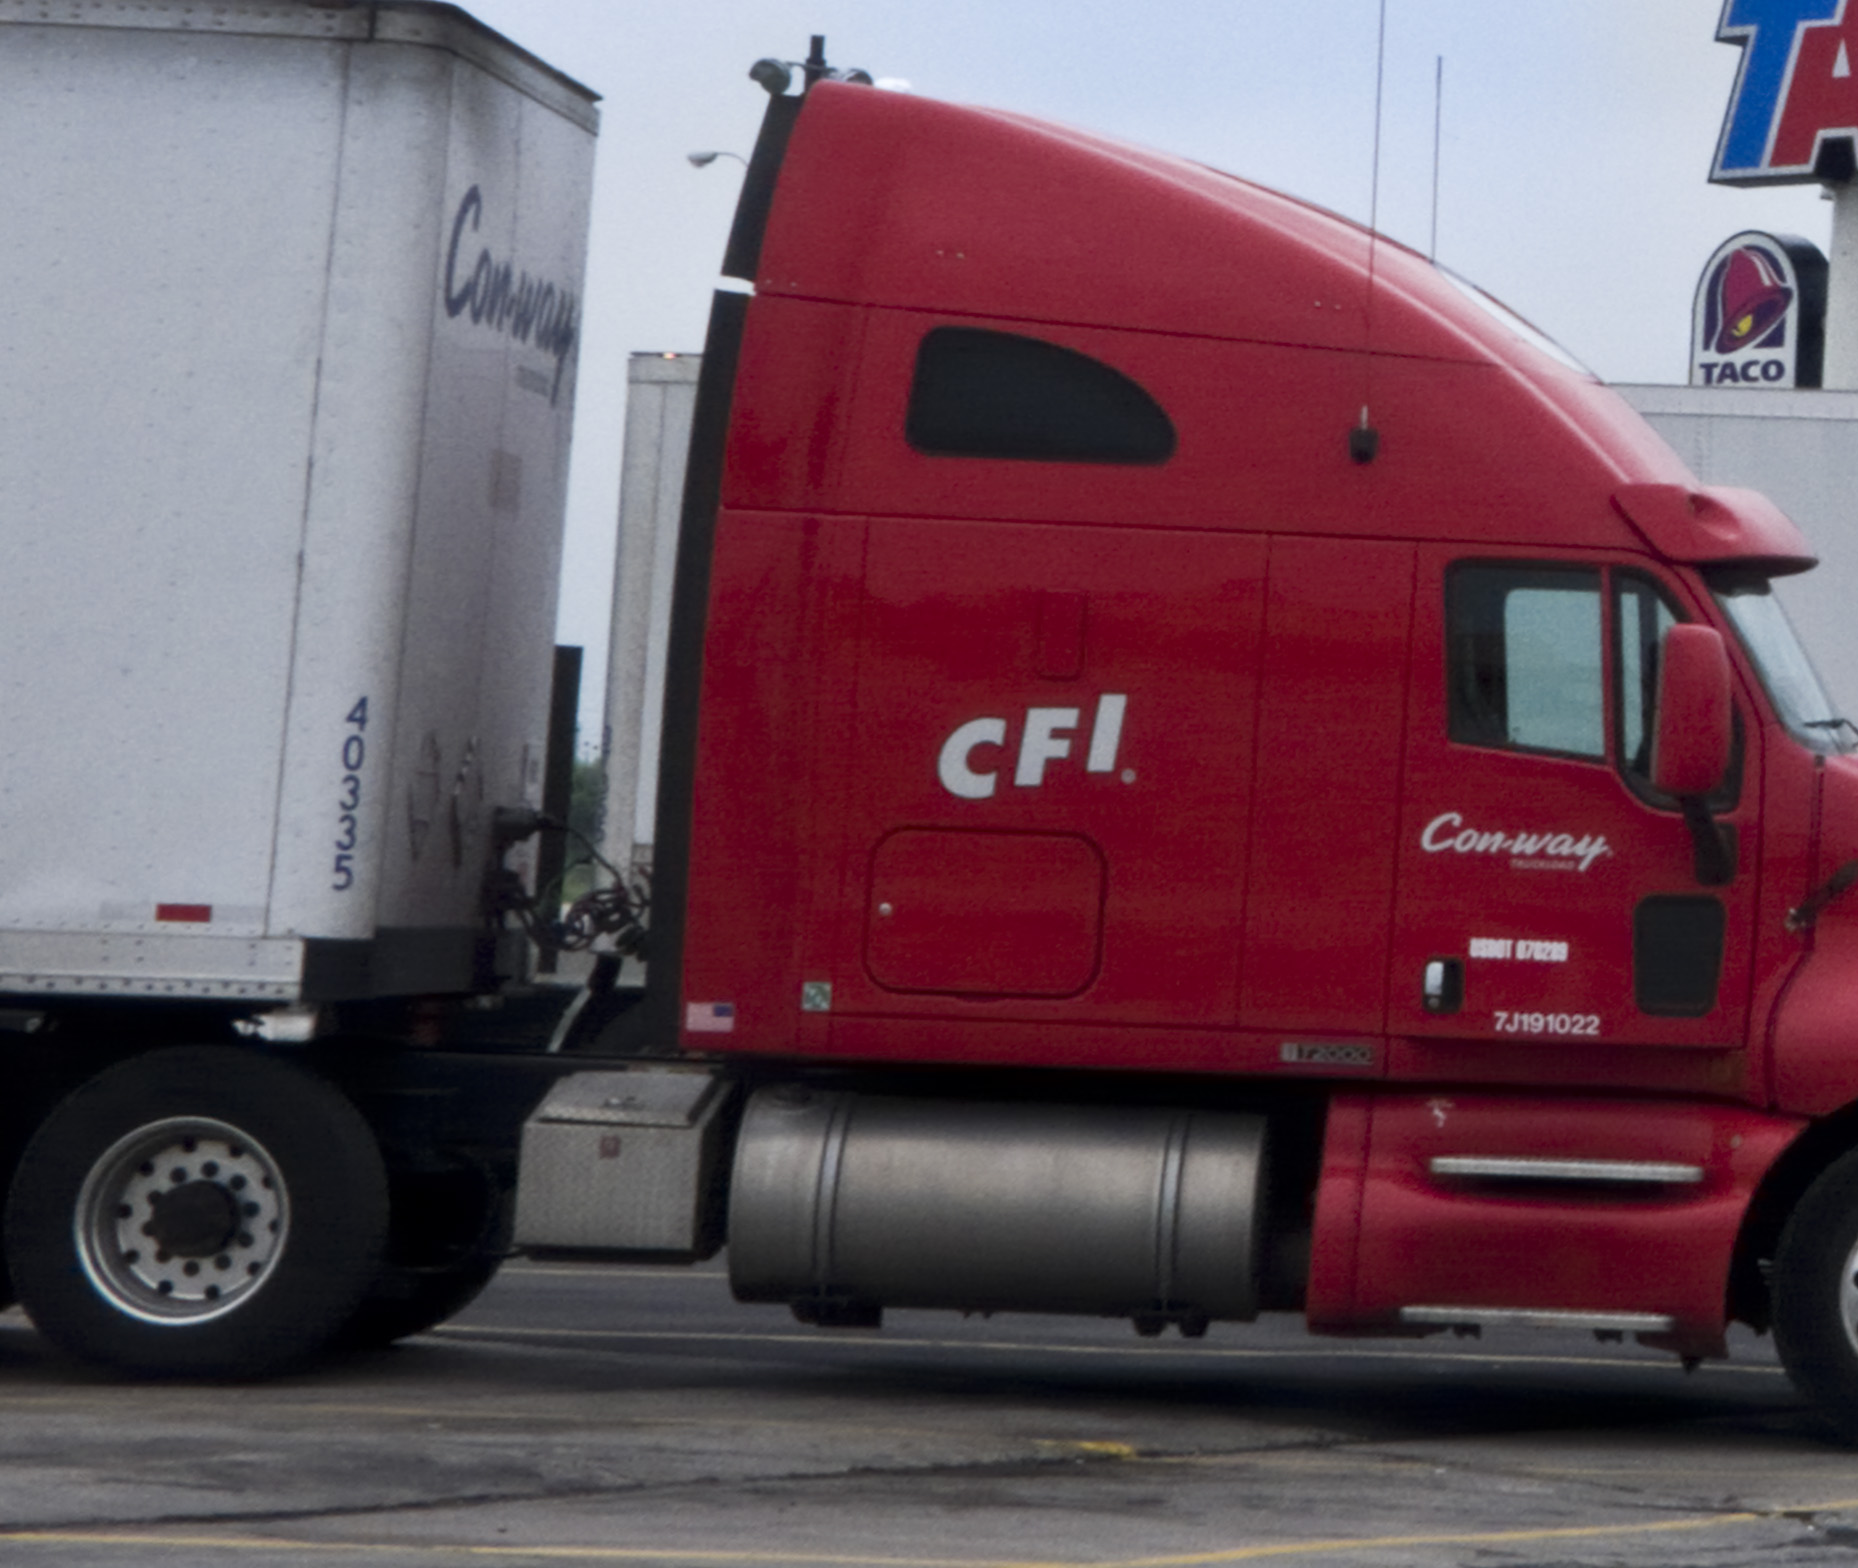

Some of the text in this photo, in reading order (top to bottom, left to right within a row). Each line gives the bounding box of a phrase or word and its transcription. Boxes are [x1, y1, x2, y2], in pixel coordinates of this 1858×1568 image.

[1698, 358, 1786, 386] TACO
[936, 692, 1128, 801] CFI
[331, 696, 370, 891] 40335
[1420, 811, 1610, 873] Con-way
[1494, 1012, 1601, 1036] 7J191022
